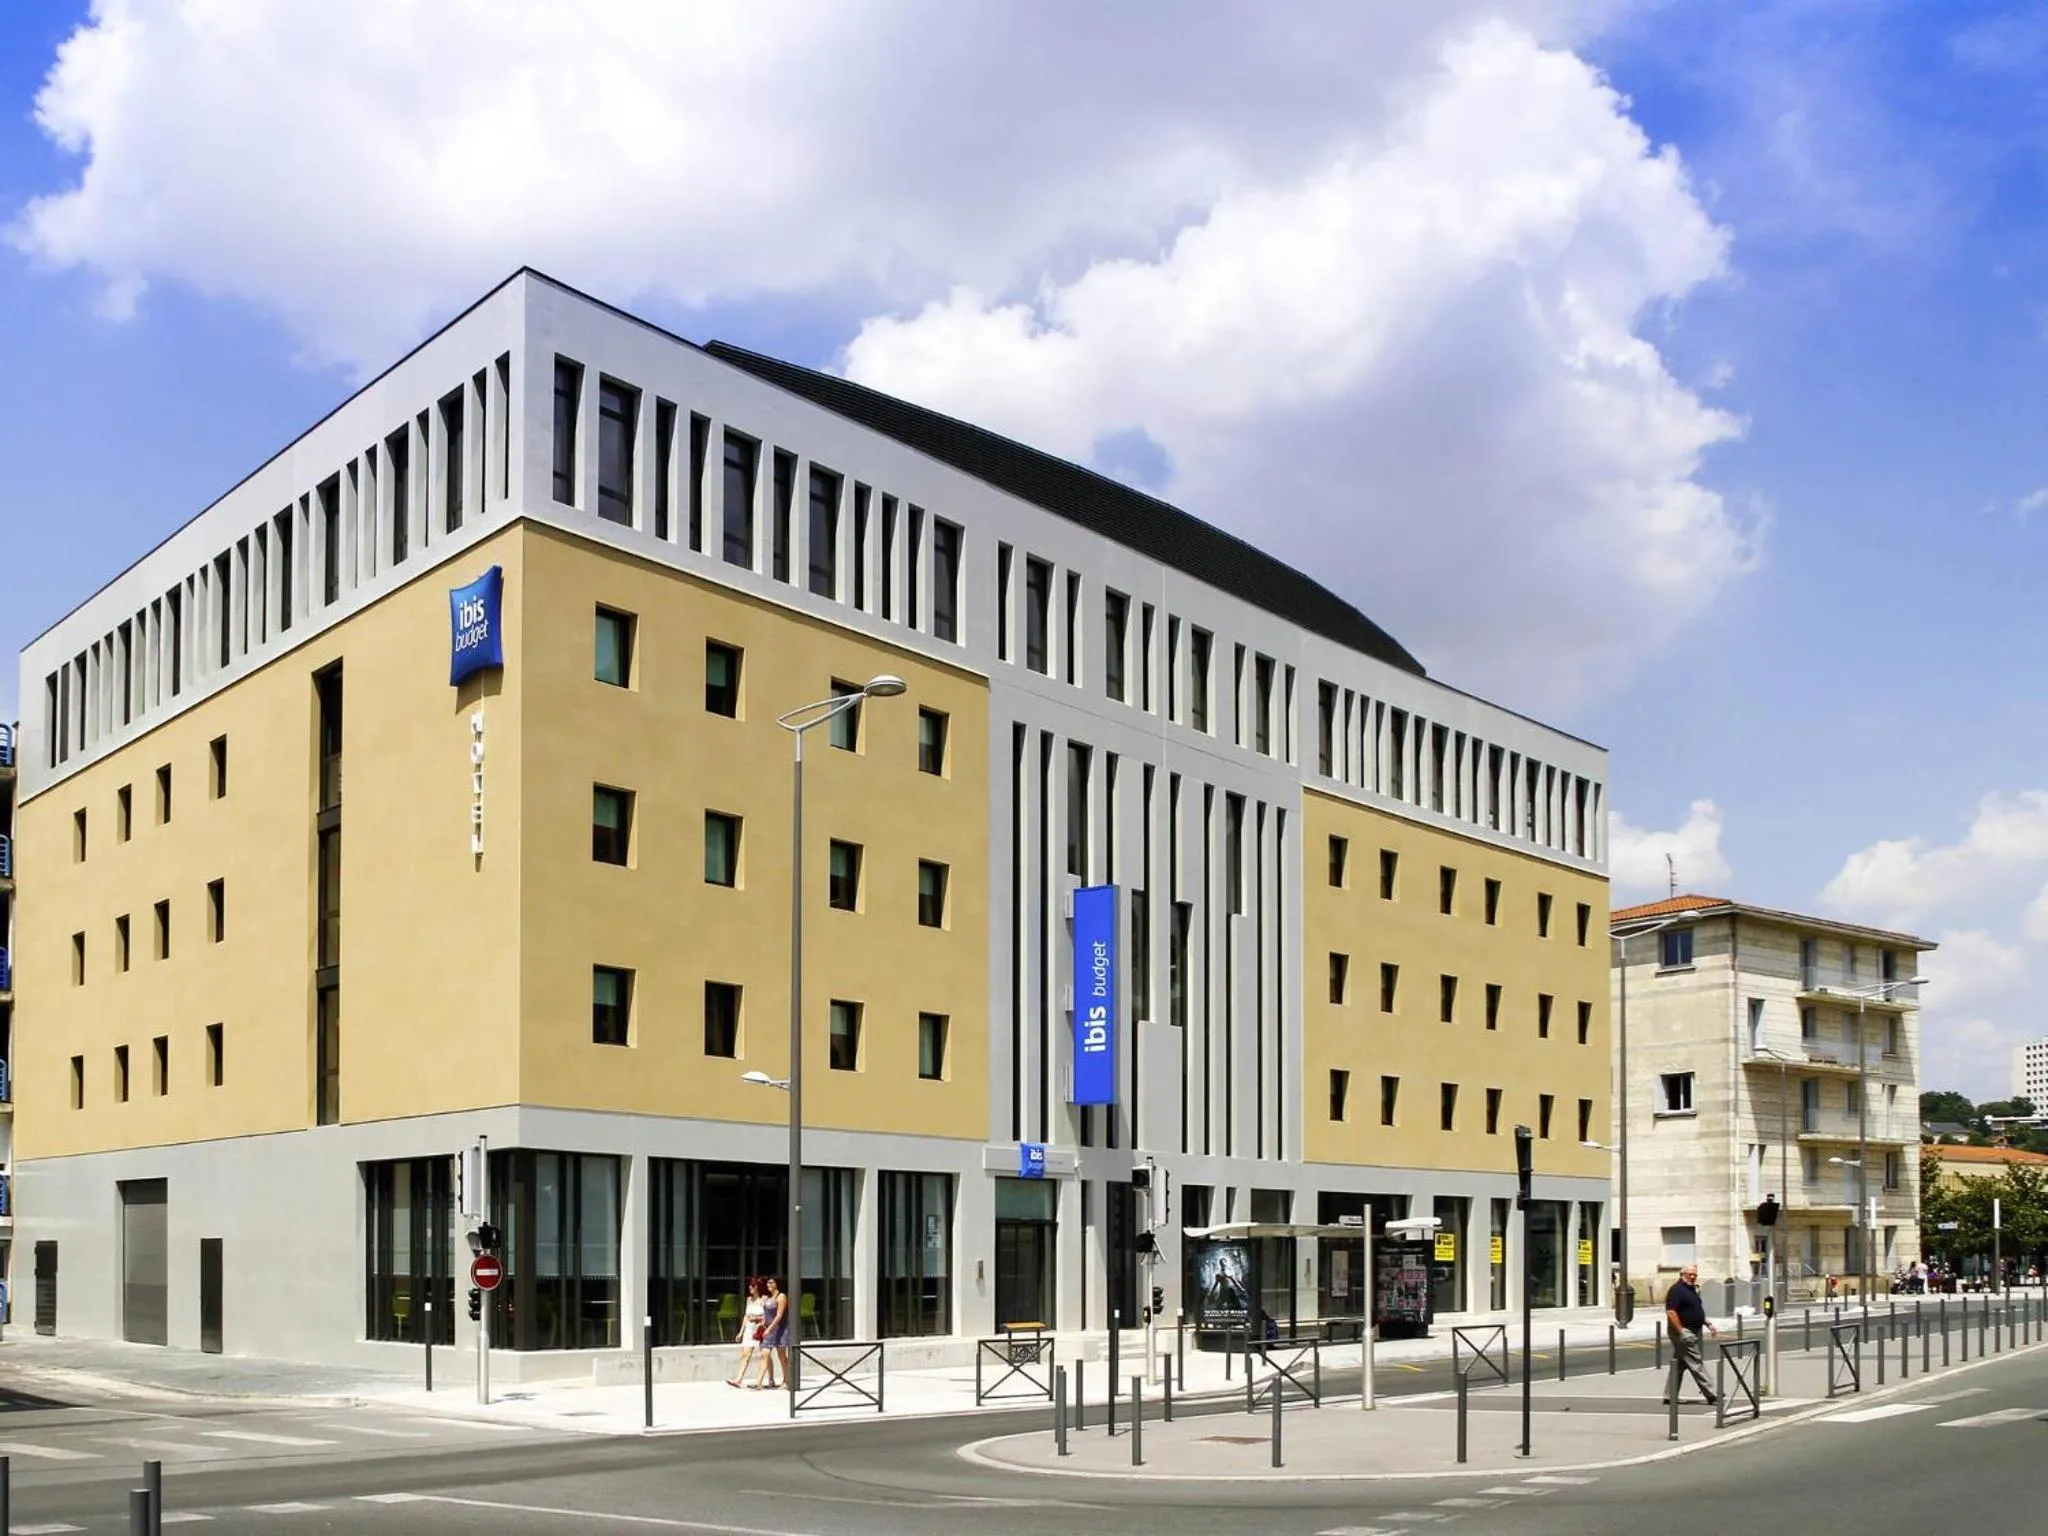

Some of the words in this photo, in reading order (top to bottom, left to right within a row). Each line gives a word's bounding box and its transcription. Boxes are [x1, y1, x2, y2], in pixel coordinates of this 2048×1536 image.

[460, 595, 485, 630] ibis
[455, 618, 489, 652] budget
[1092, 940, 1110, 997] budget
[1084, 1006, 1107, 1053] ibis
